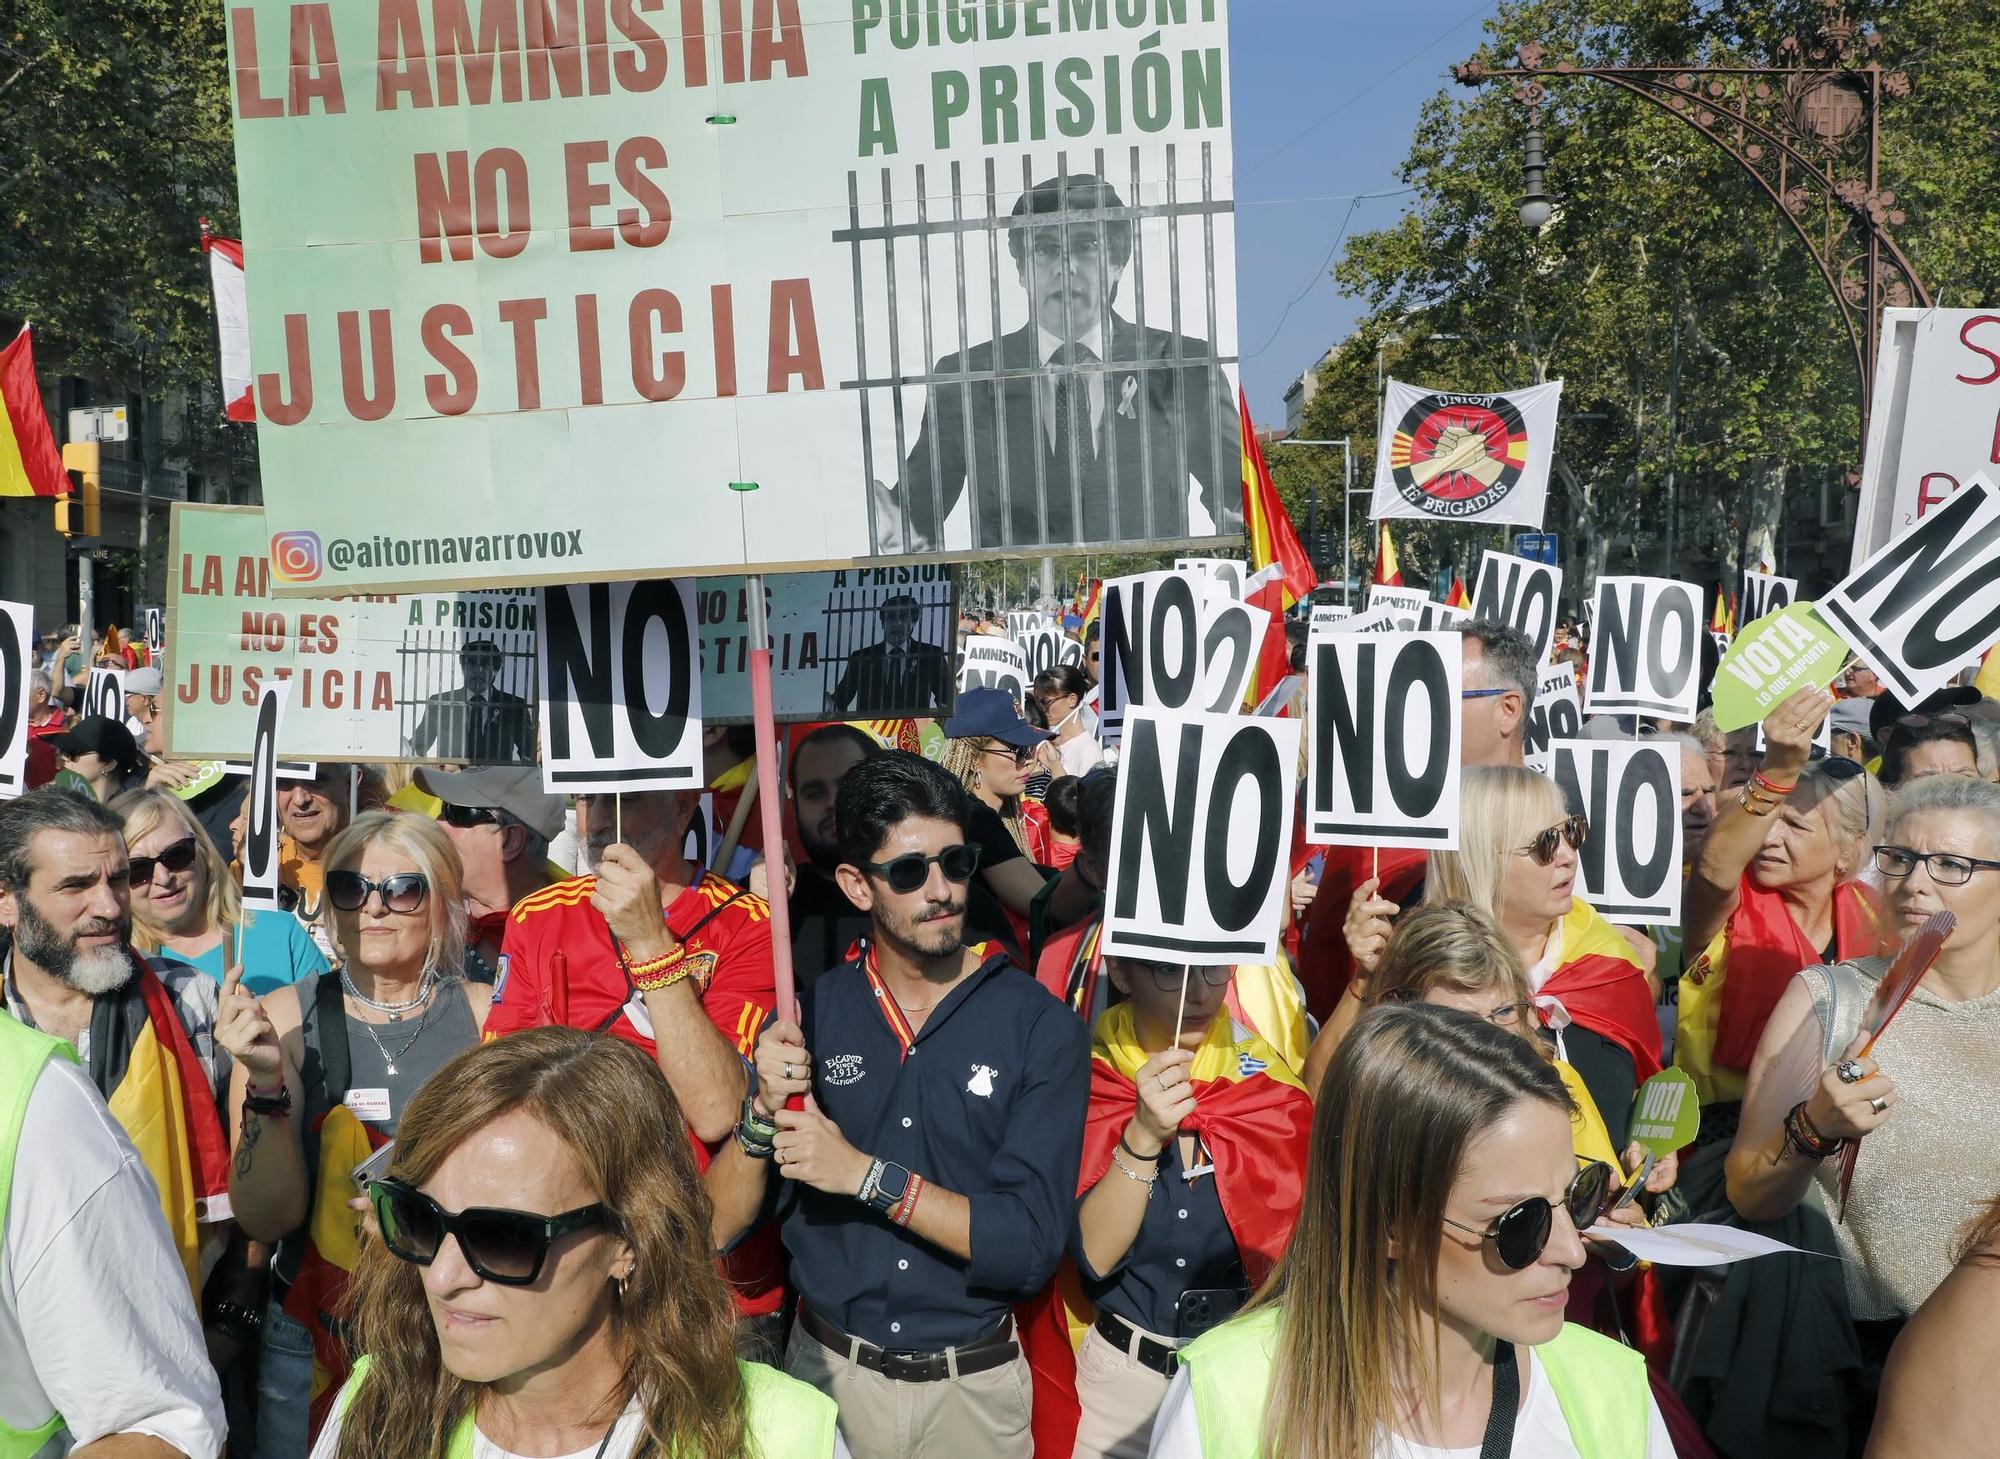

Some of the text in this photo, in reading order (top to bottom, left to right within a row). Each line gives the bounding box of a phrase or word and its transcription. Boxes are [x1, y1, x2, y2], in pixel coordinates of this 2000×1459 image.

[231, 3, 346, 119] LA
[858, 30, 1224, 157] A PRISIÓN
[414, 136, 672, 264] NO ES
[258, 278, 824, 426] JUSTICIA
[1422, 482, 1508, 514] BRIGADAS
[181, 553, 223, 596] LA
[327, 529, 583, 571] @aitornavarrovox
[1844, 483, 2000, 669] NO
[240, 611, 340, 654] NO ES
[408, 596, 536, 631] A PRISIÓN
[1103, 575, 1197, 711] NO
[1473, 557, 1553, 662] NO
[1591, 582, 1696, 700] NO
[1724, 613, 1816, 690] VOTA
[84, 671, 121, 720] NO
[545, 578, 690, 759] NO
[969, 647, 1023, 671] AMNISTIA
[1755, 640, 1832, 708] LO QUE IMPORTA
[1315, 639, 1451, 819] NO
[1524, 698, 1579, 756] NO
[1114, 718, 1283, 932] NO
[1553, 748, 1675, 899] NO
[832, 1066, 859, 1078] 1915
[1640, 1082, 1687, 1122] VOTA
